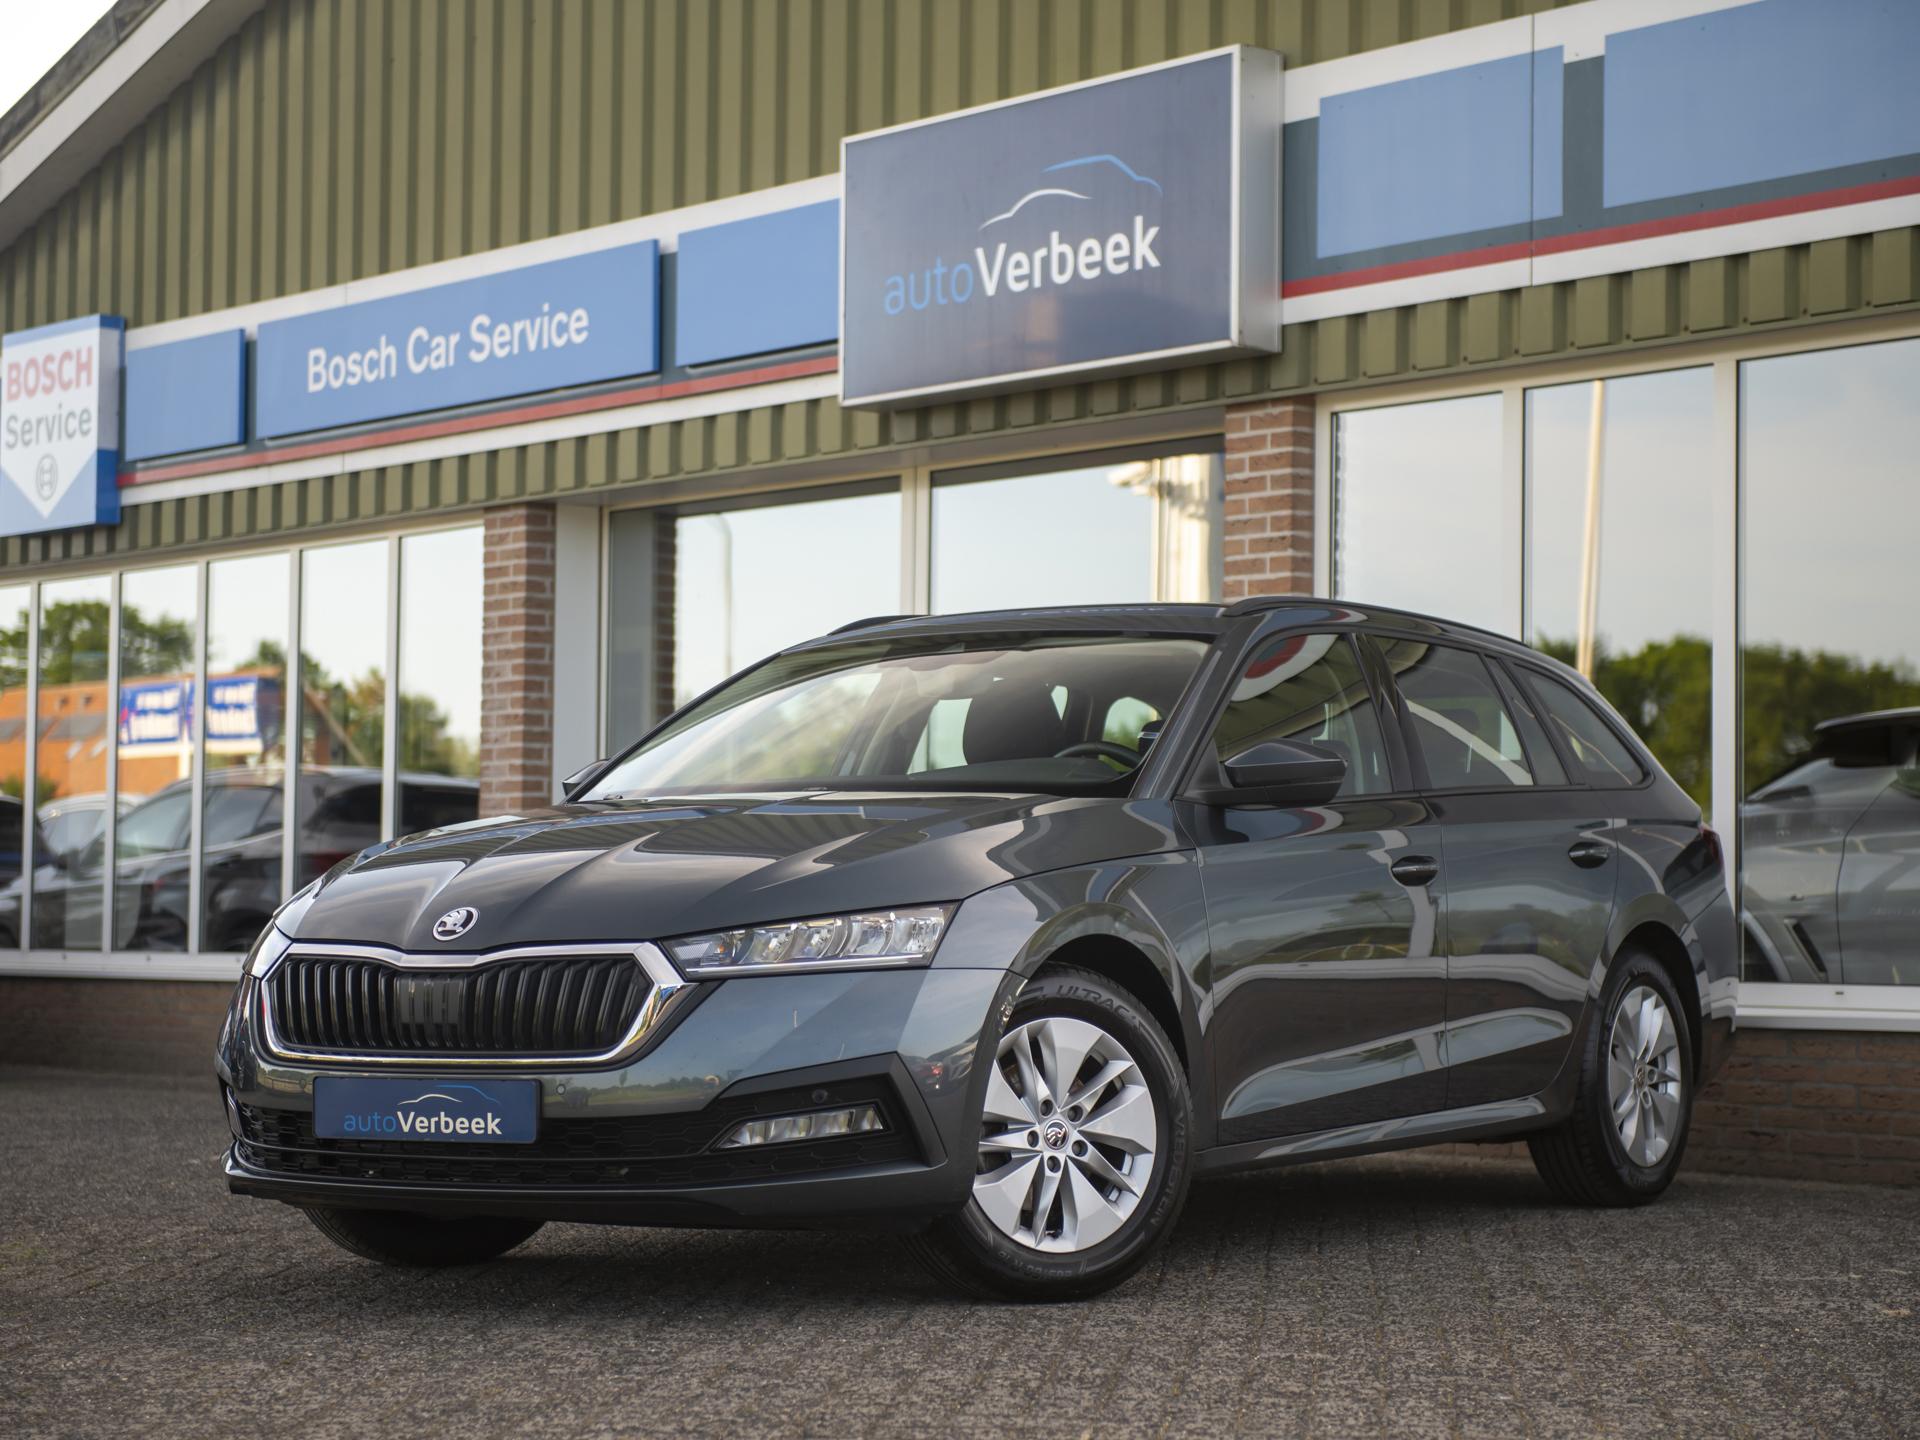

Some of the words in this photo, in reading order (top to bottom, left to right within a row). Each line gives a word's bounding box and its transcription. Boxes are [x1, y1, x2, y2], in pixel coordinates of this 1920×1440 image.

[884, 215, 1161, 316] autoVerbeek
[307, 335, 397, 393] Bosch
[406, 326, 460, 374] Car
[469, 303, 589, 363] Service
[6, 347, 93, 402] BOSCH
[5, 404, 92, 450] Service
[1056, 985, 1130, 1020] ULTRAC
[343, 1111, 503, 1135] autoVerbeek
